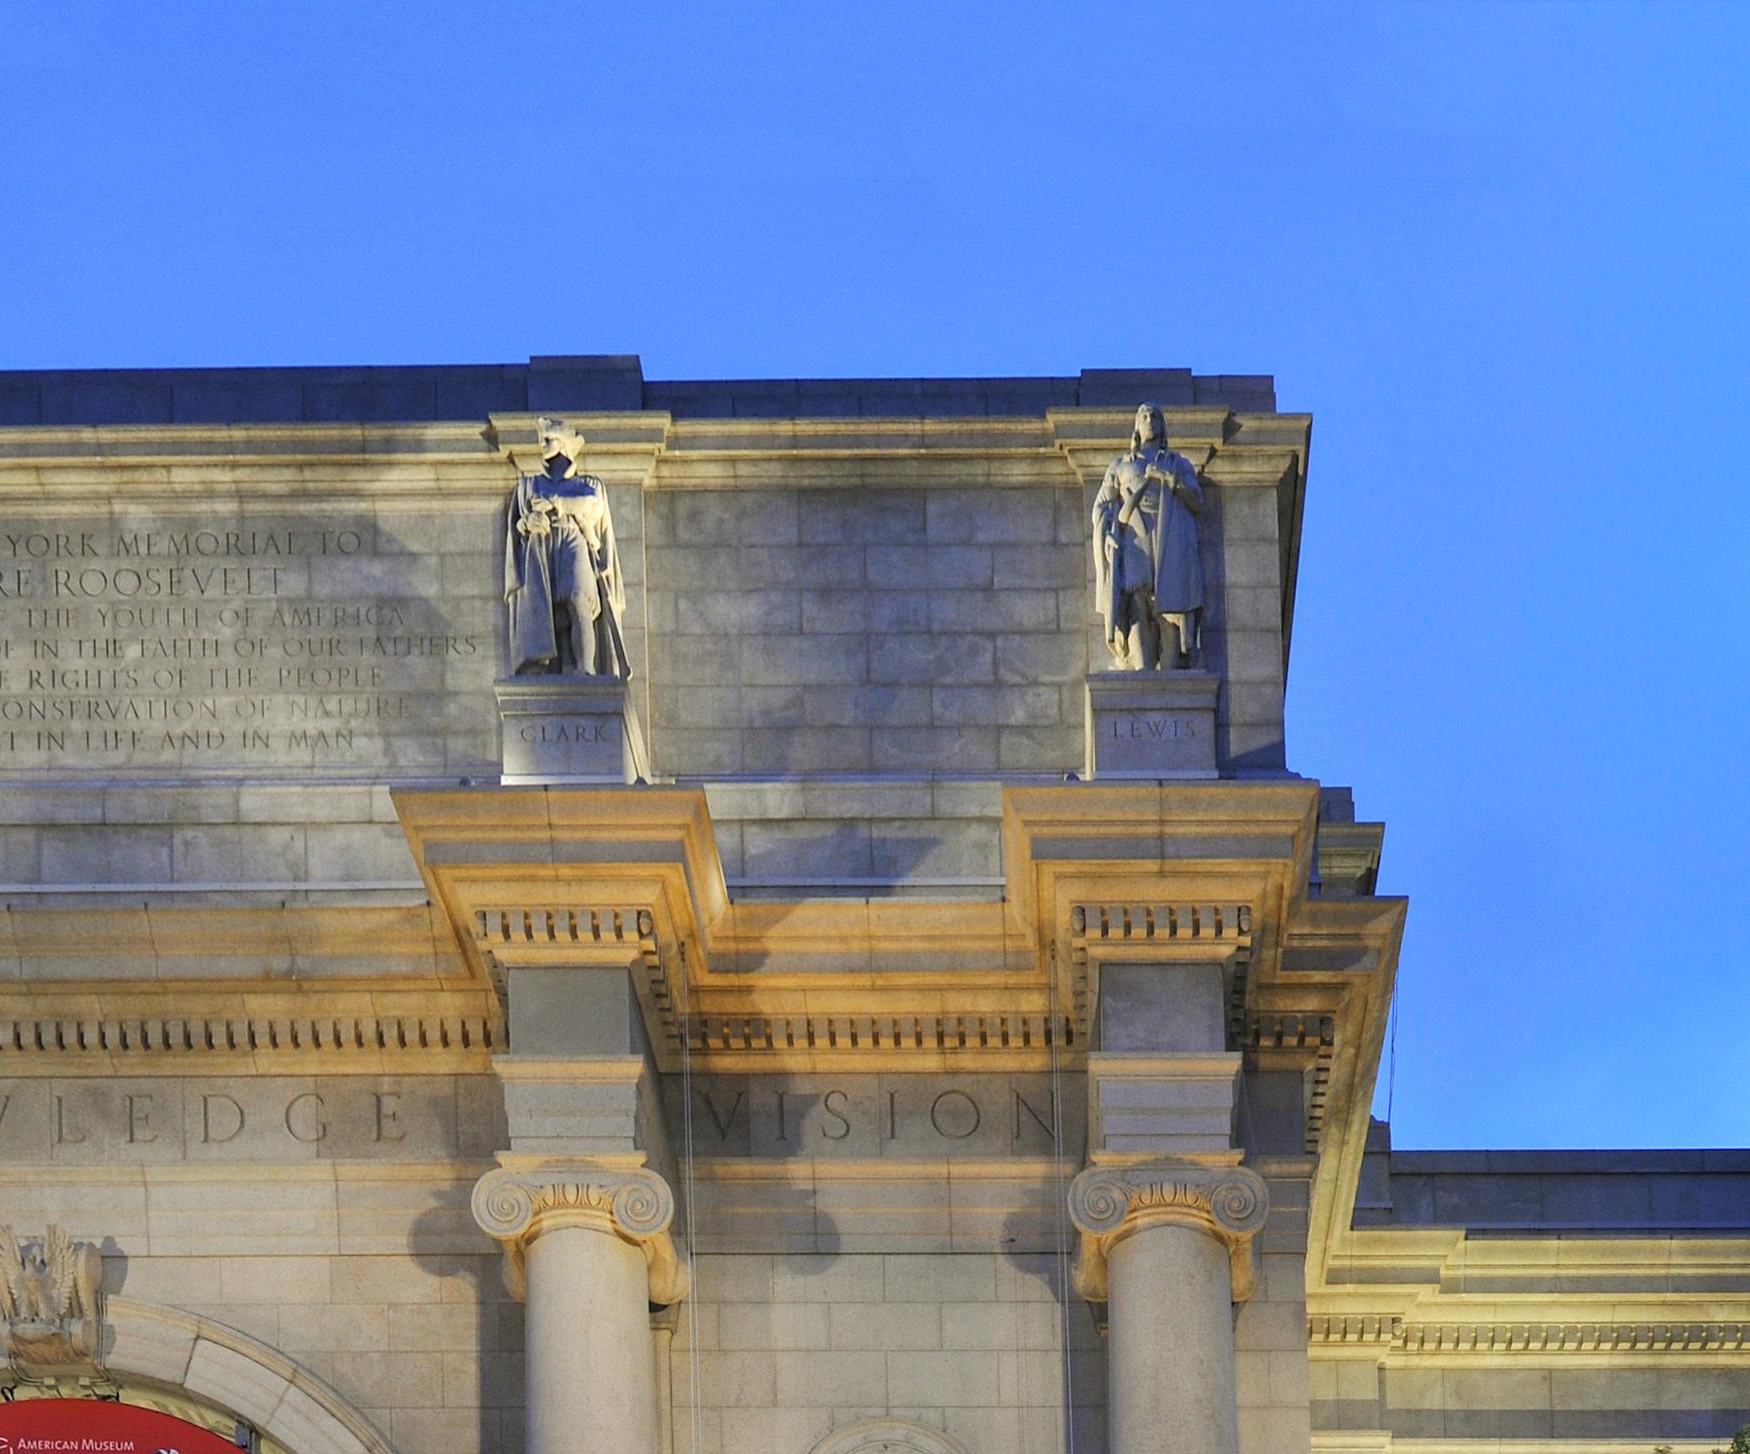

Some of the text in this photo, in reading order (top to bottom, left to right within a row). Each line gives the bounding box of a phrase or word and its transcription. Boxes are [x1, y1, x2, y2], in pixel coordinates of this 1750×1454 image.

[7, 533, 98, 557] YORK
[116, 531, 301, 557] MEMORIAL
[315, 531, 361, 554] TO
[54, 567, 285, 597] ROOSEVELT
[27, 608, 76, 628] THE
[98, 607, 199, 627] YOUTH
[219, 607, 257, 627] OF
[271, 606, 404, 627] AMERICA
[34, 639, 58, 658] IN
[76, 639, 123, 658] THE
[141, 638, 219, 658] FAITH
[234, 638, 270, 657] OF
[283, 637, 347, 657] OUR
[359, 635, 476, 656] FATHERS
[29, 669, 138, 690] RIGHTS
[153, 668, 188, 689] OF
[209, 668, 258, 688] THE
[279, 667, 383, 688] PEOPLE
[235, 699, 272, 718] OF
[291, 698, 411, 719] NATURE
[37, 731, 64, 750] IN
[86, 730, 143, 750] LIFE
[162, 730, 225, 750] AND
[242, 730, 270, 749] IN
[288, 729, 355, 749] MAN
[520, 724, 606, 743] CLARK
[1113, 719, 1195, 738] LEWIS
[699, 1089, 1056, 1141] VISION
[17, 1438, 135, 1451] AMERICAN MUSEUM
